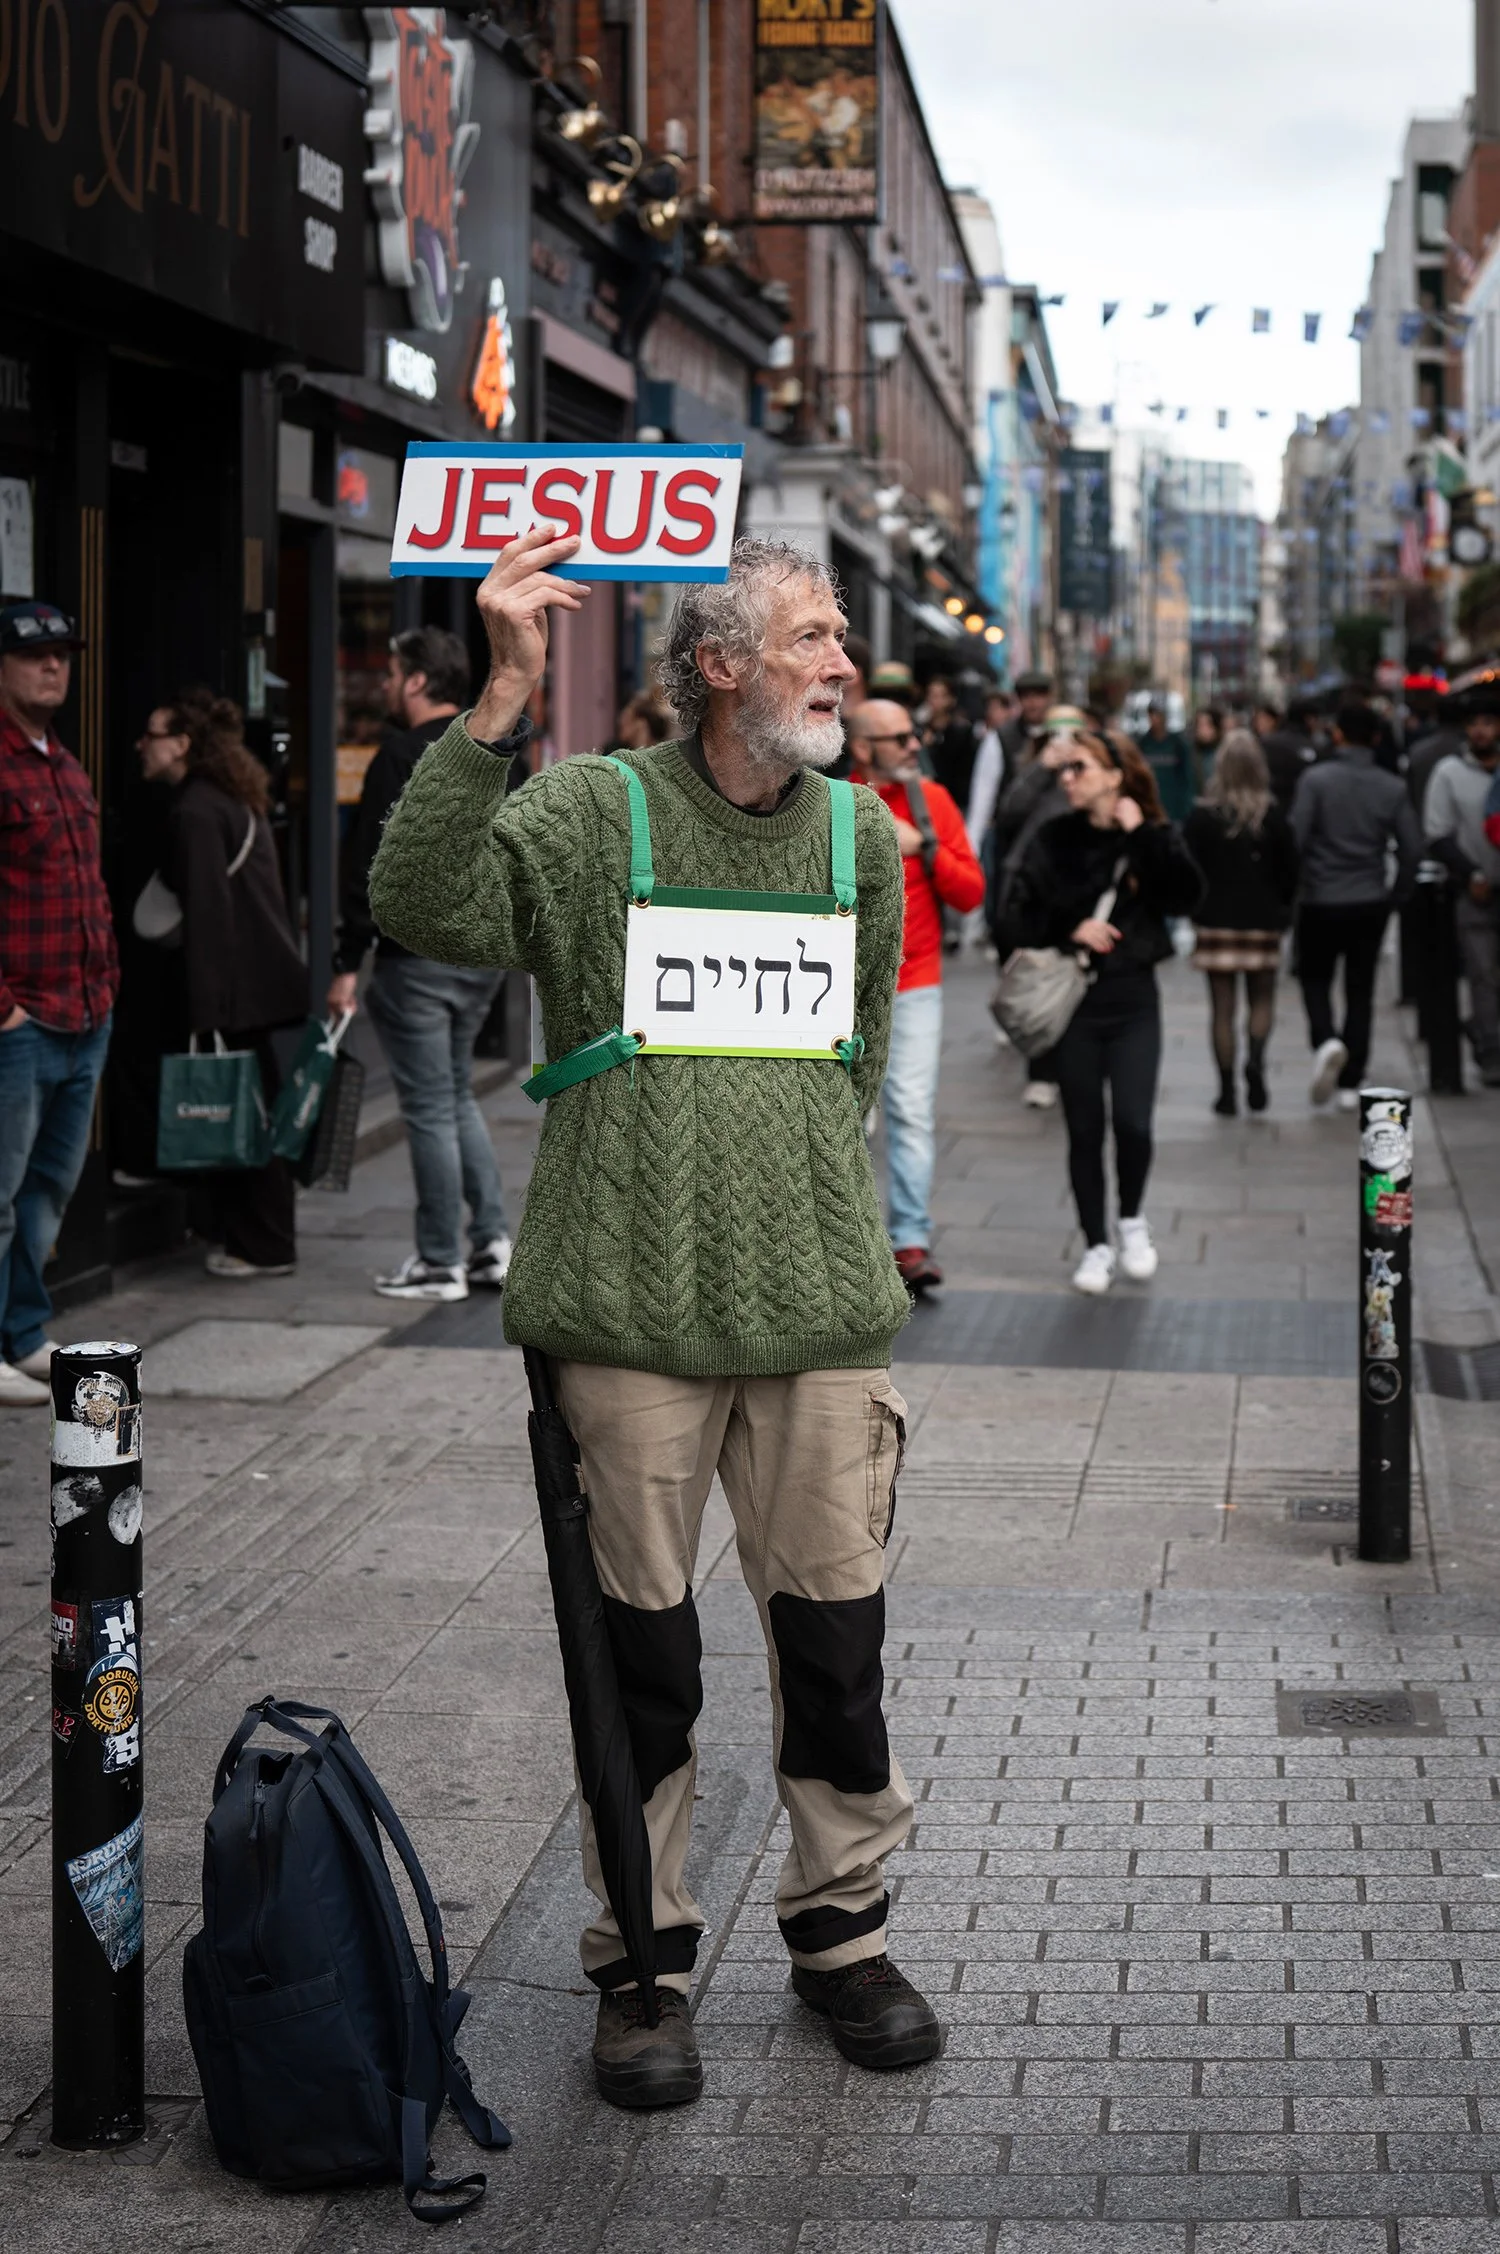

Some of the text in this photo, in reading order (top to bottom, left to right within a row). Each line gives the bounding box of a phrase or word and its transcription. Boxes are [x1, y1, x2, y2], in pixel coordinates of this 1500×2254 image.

[0, 0, 71, 144] IO
[73, 0, 252, 238] GATTI
[406, 465, 721, 554] JESUS
[655, 937, 833, 1015] לחיים
[84, 1703, 134, 1734] DORTMUND
[98, 1670, 140, 1695] BORUSSIA
